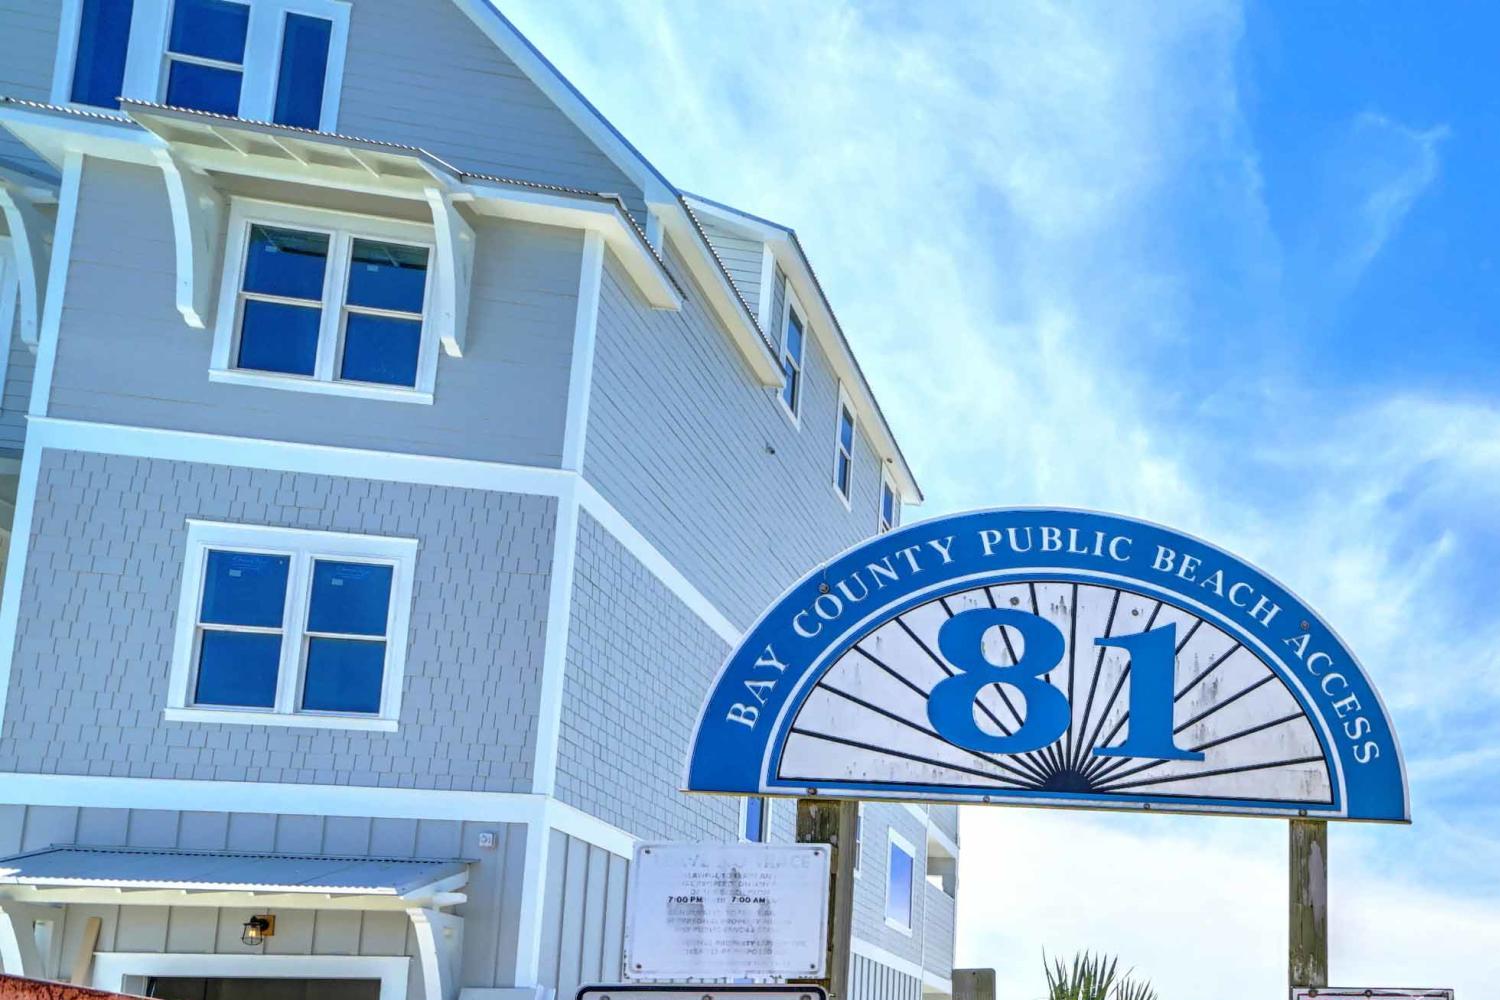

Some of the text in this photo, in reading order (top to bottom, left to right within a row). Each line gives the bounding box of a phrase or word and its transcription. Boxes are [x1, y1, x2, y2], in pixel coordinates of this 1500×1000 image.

[726, 526, 1380, 765] BAY COUNTY PUBLIC BEACH ACCESS
[926, 607, 1205, 762] 81
[690, 896, 703, 904] PM
[753, 896, 766, 904] AM
